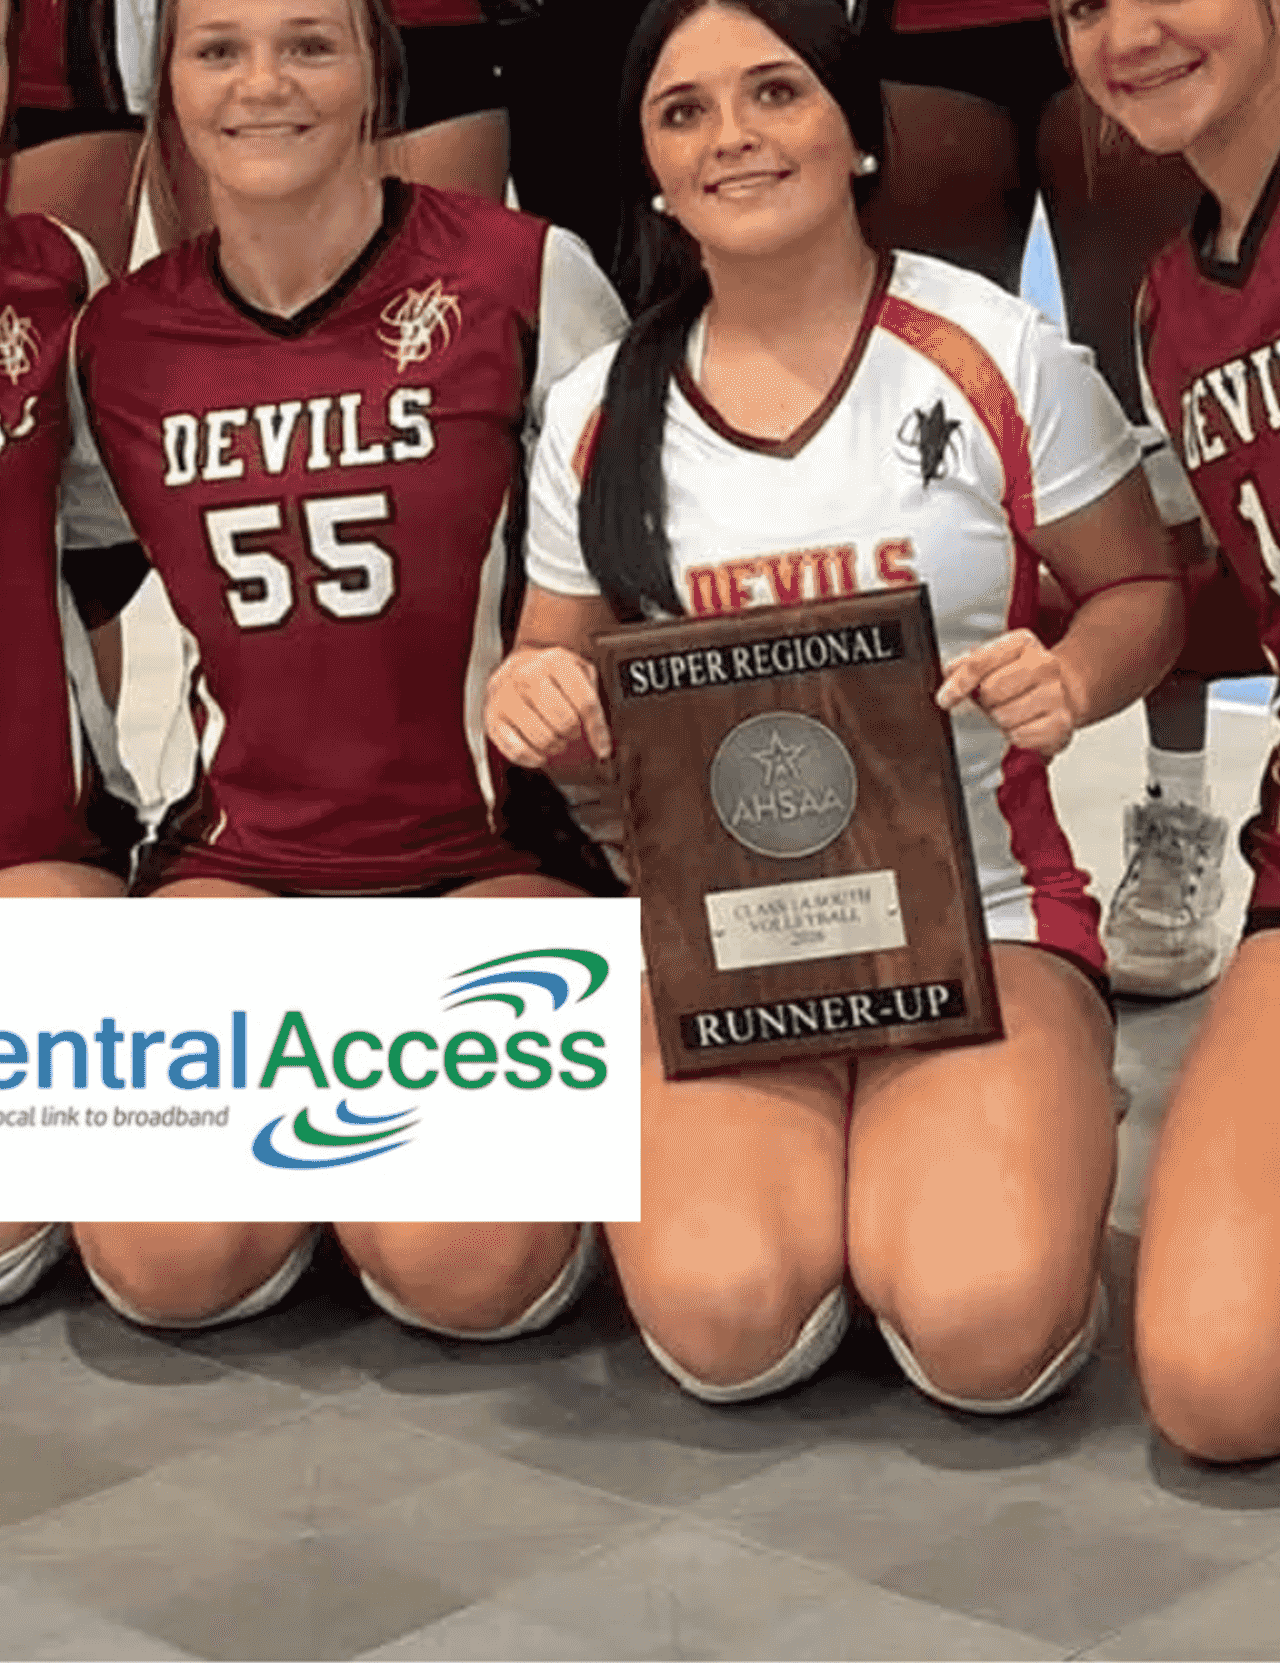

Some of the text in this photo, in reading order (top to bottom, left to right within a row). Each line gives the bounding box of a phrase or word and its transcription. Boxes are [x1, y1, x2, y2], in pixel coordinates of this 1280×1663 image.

[163, 388, 434, 487] DEVILS
[205, 493, 395, 628] 55
[629, 627, 894, 694] SUPER REGIONAL
[732, 790, 844, 825] AHSAA
[696, 984, 950, 1047] RUNNER-UP
